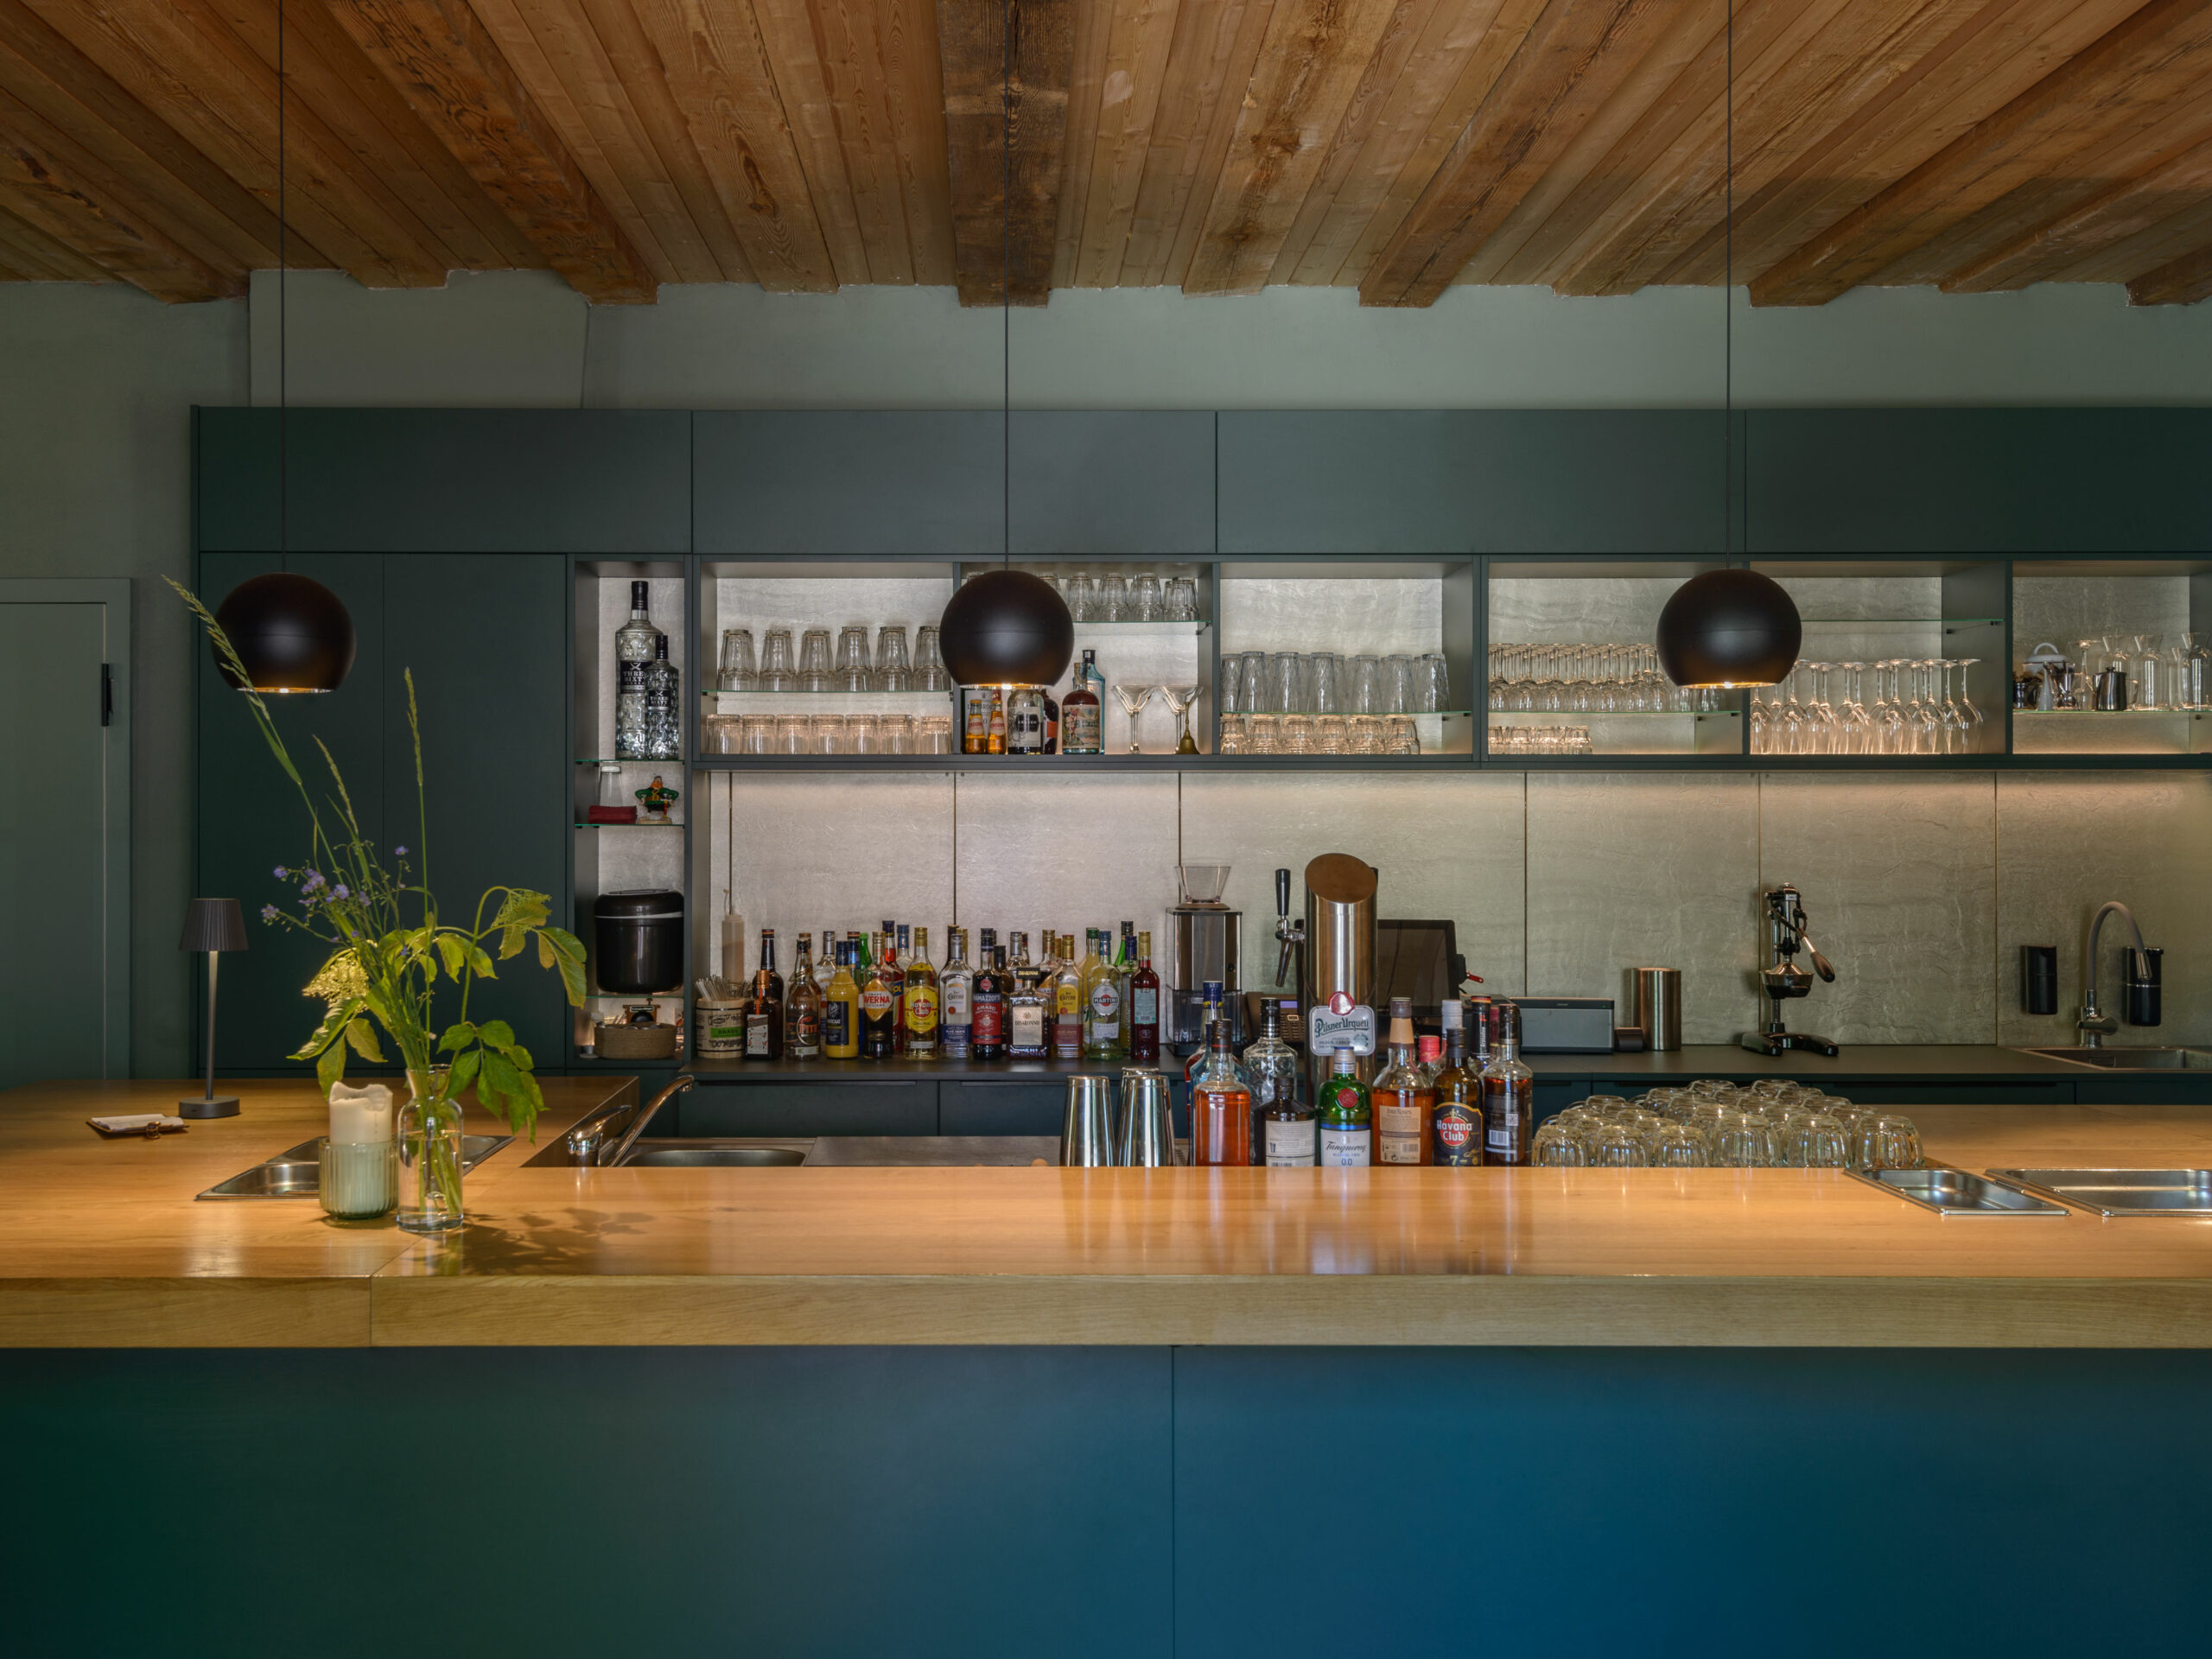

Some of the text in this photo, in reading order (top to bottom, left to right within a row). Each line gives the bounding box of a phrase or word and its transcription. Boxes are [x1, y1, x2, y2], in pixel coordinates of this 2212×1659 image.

[914, 1007, 929, 1015] Club
[1314, 1018, 1342, 1038] Pilsner
[1436, 1120, 1473, 1131] Havana
[1442, 1131, 1465, 1141] Club
[1341, 1158, 1353, 1166] 0.0
[1449, 1155, 1459, 1166] 7
